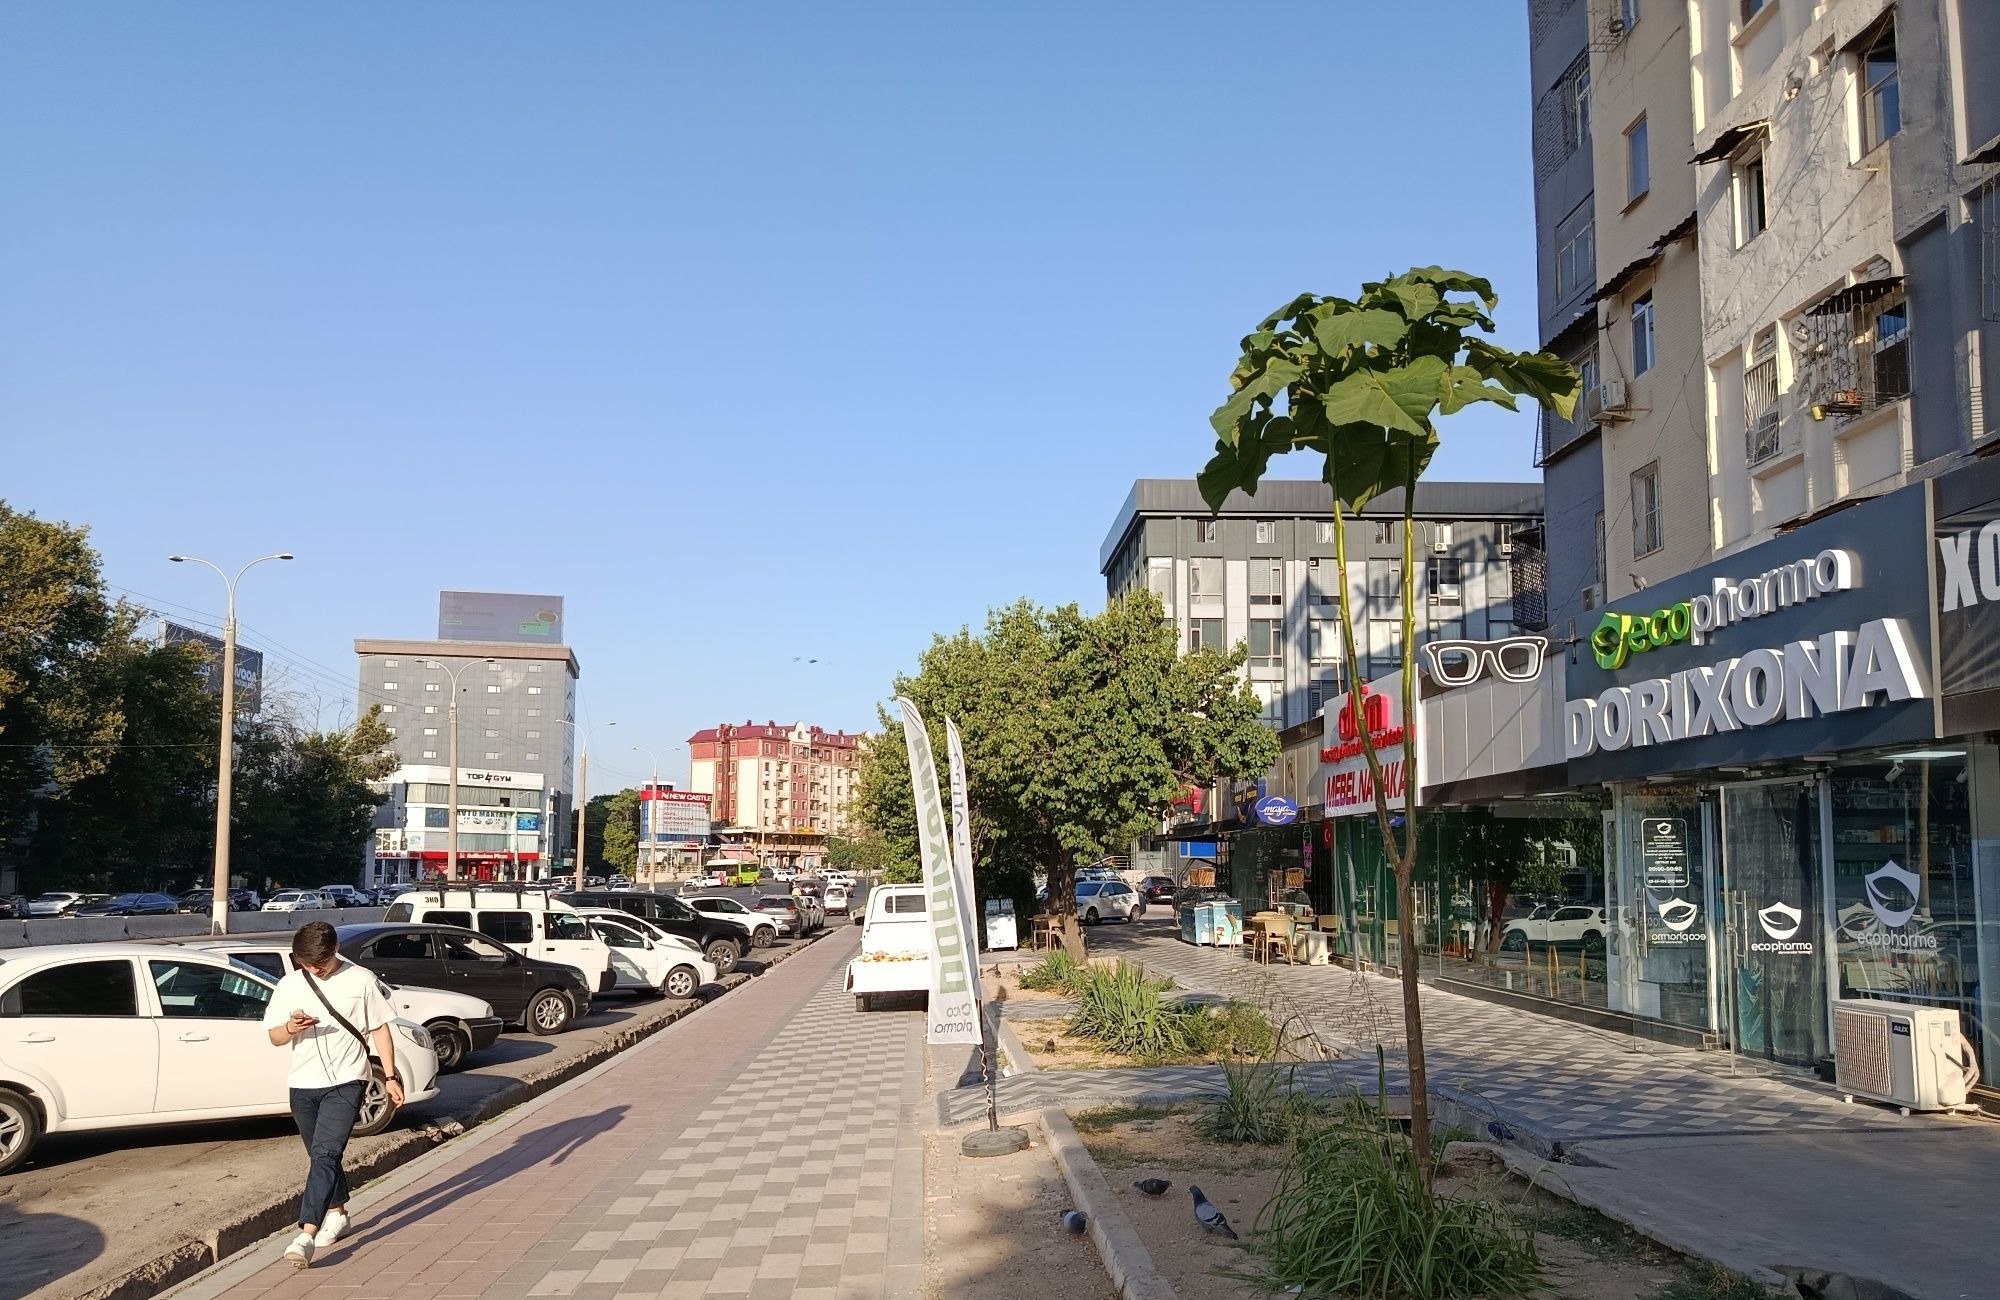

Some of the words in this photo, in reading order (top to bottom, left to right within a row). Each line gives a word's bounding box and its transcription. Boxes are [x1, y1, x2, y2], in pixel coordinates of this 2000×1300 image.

[1565, 618, 1925, 759] DORIXONA
[1327, 771, 1357, 808] MEBEL
[1264, 805, 1290, 816] maya
[1751, 941, 1813, 953] ecopharma
[1857, 930, 1937, 949] ecopharma
